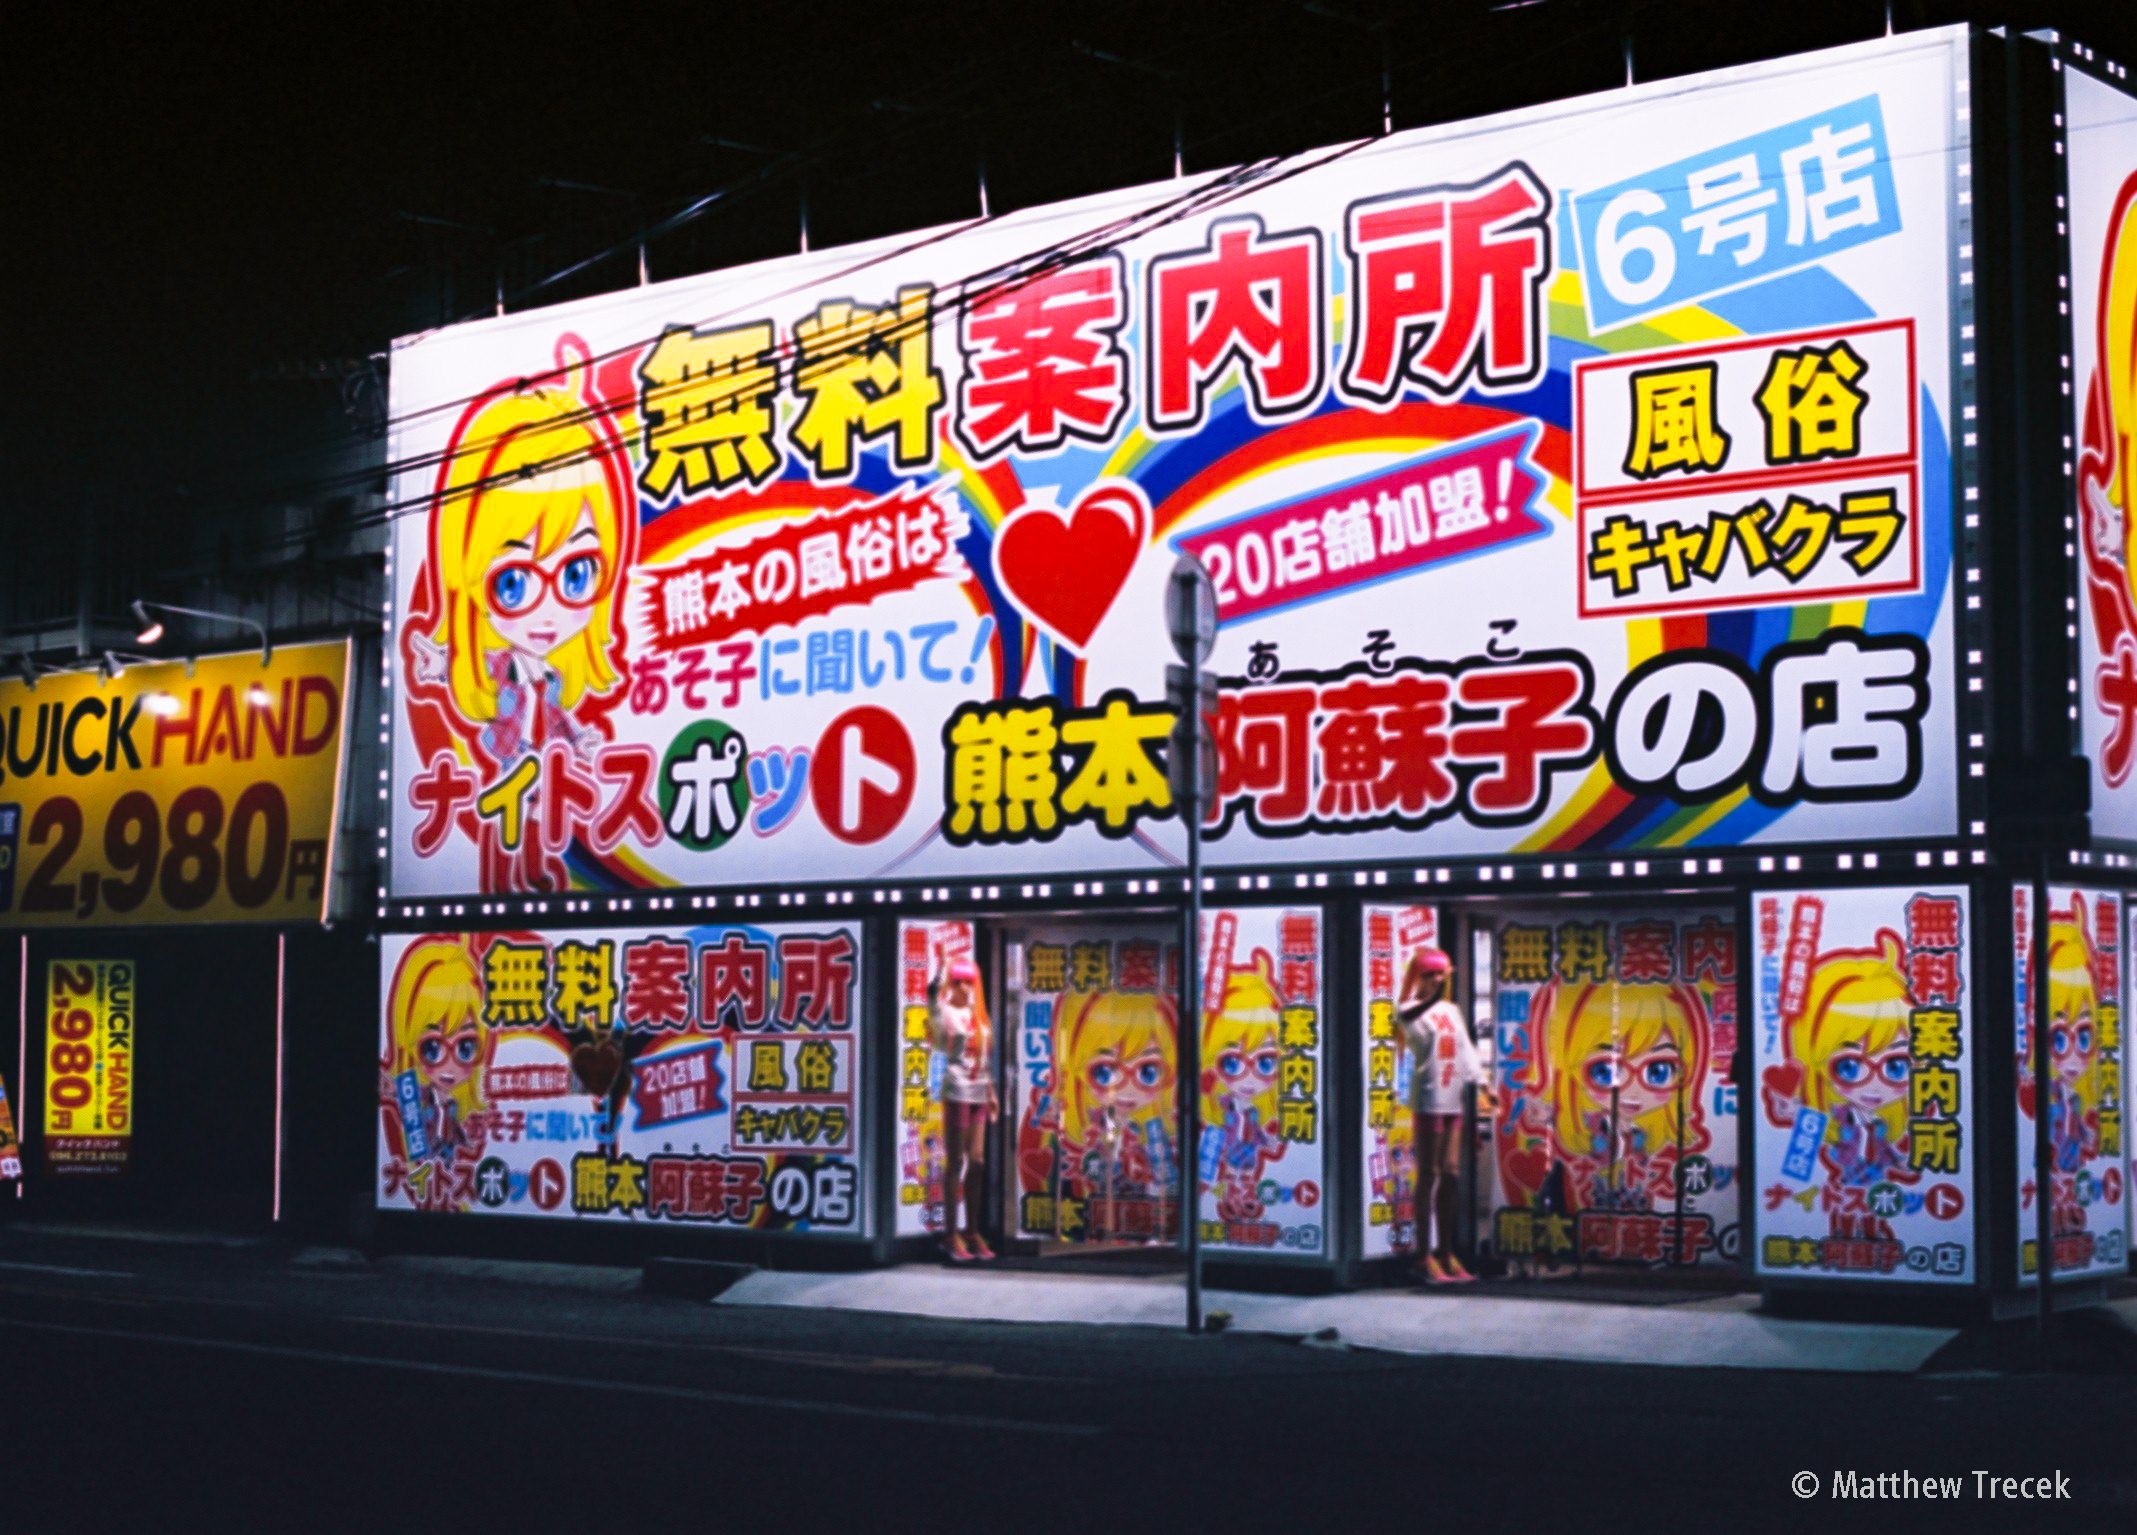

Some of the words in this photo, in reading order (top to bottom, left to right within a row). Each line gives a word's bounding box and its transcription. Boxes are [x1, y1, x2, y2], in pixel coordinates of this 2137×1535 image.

[1595, 122, 1881, 306] 6号店
[638, 162, 1552, 502] 無料案内所
[1623, 340, 1870, 481] 風俗
[662, 499, 944, 635] 熊本の風俗は
[1589, 486, 1908, 597] キャバクラ
[0, 695, 142, 789] UICK
[152, 675, 342, 768] HAND
[408, 706, 917, 858] ナイトスポット
[942, 625, 1931, 848] 熊本阿蘇子の店
[19, 780, 328, 920] 2,980円
[49, 962, 97, 1131] 2,980円
[108, 962, 133, 1050] QUICK
[481, 929, 859, 1032] 無料案内所
[1905, 893, 1962, 1174] 無料案内所
[107, 1052, 130, 1131] HAND
[736, 1104, 847, 1146] キャバクラ
[748, 1040, 838, 1092] 風俗
[570, 1151, 858, 1224] 熊本阿蘇子の店
